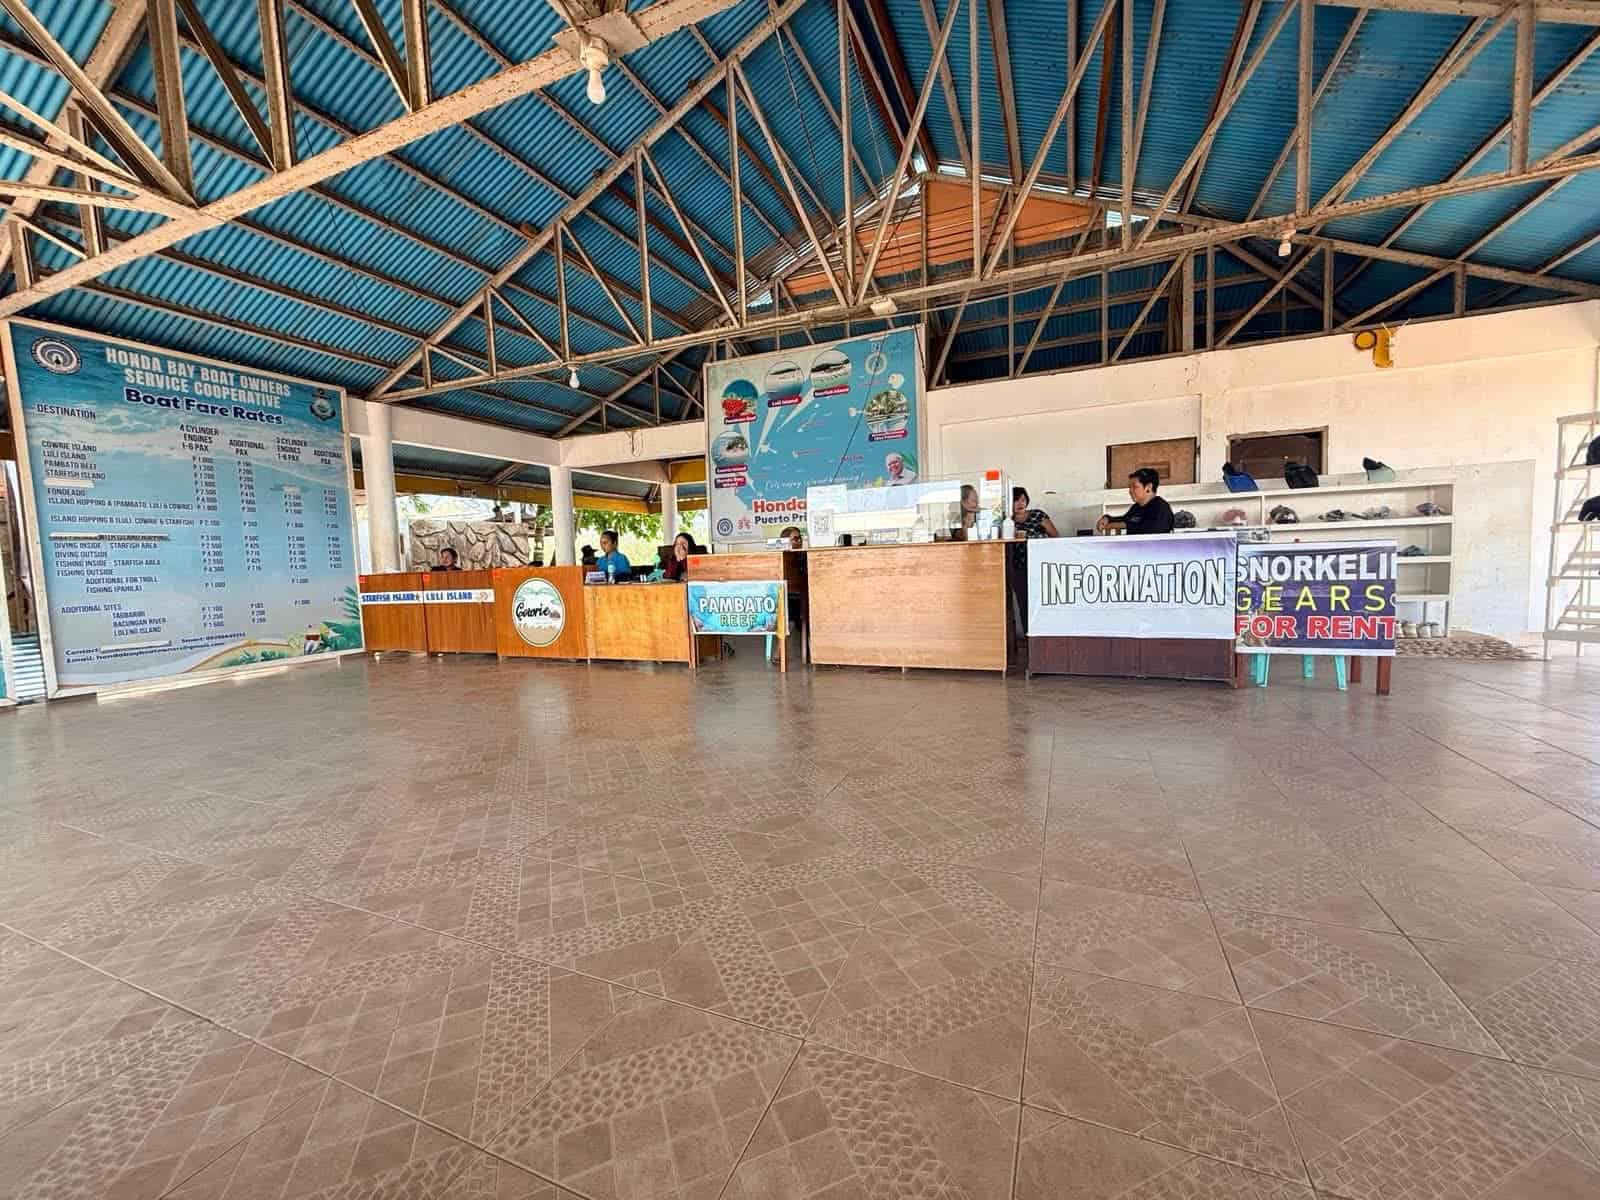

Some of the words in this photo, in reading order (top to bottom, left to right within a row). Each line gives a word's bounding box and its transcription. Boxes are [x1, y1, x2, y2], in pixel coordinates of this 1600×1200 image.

[106, 347, 162, 373] HONDA
[166, 360, 195, 379] BAY
[200, 366, 235, 386] BOAT
[239, 375, 291, 396] OWNERS
[124, 368, 189, 394] SERVICE
[194, 381, 281, 409] COOPERATIVE
[36, 403, 96, 420] DESTINATION
[125, 388, 182, 410] Boat
[184, 399, 230, 417] Fare
[232, 405, 283, 424] Rates
[186, 425, 219, 436] CYLINDER
[184, 434, 213, 444] ENGINES
[229, 439, 265, 450] ADDITIONAL
[41, 440, 70, 450] COWRIE
[71, 442, 97, 452] ISLAND
[195, 443, 209, 452] PAX
[61, 451, 86, 460] ISLAND
[235, 449, 249, 457] PAX
[81, 471, 106, 481] ISLAND
[755, 515, 790, 525] Puerto
[1040, 557, 1227, 607] INFORMATION
[392, 592, 416, 602] ISLAND
[425, 591, 444, 601] LULI
[446, 591, 473, 600] ISLAND
[1236, 584, 1387, 612] GEARS
[698, 595, 777, 614] PAMBATO
[720, 614, 758, 627] REEF
[1235, 614, 1298, 639] FOR
[1306, 614, 1396, 640] RENT
